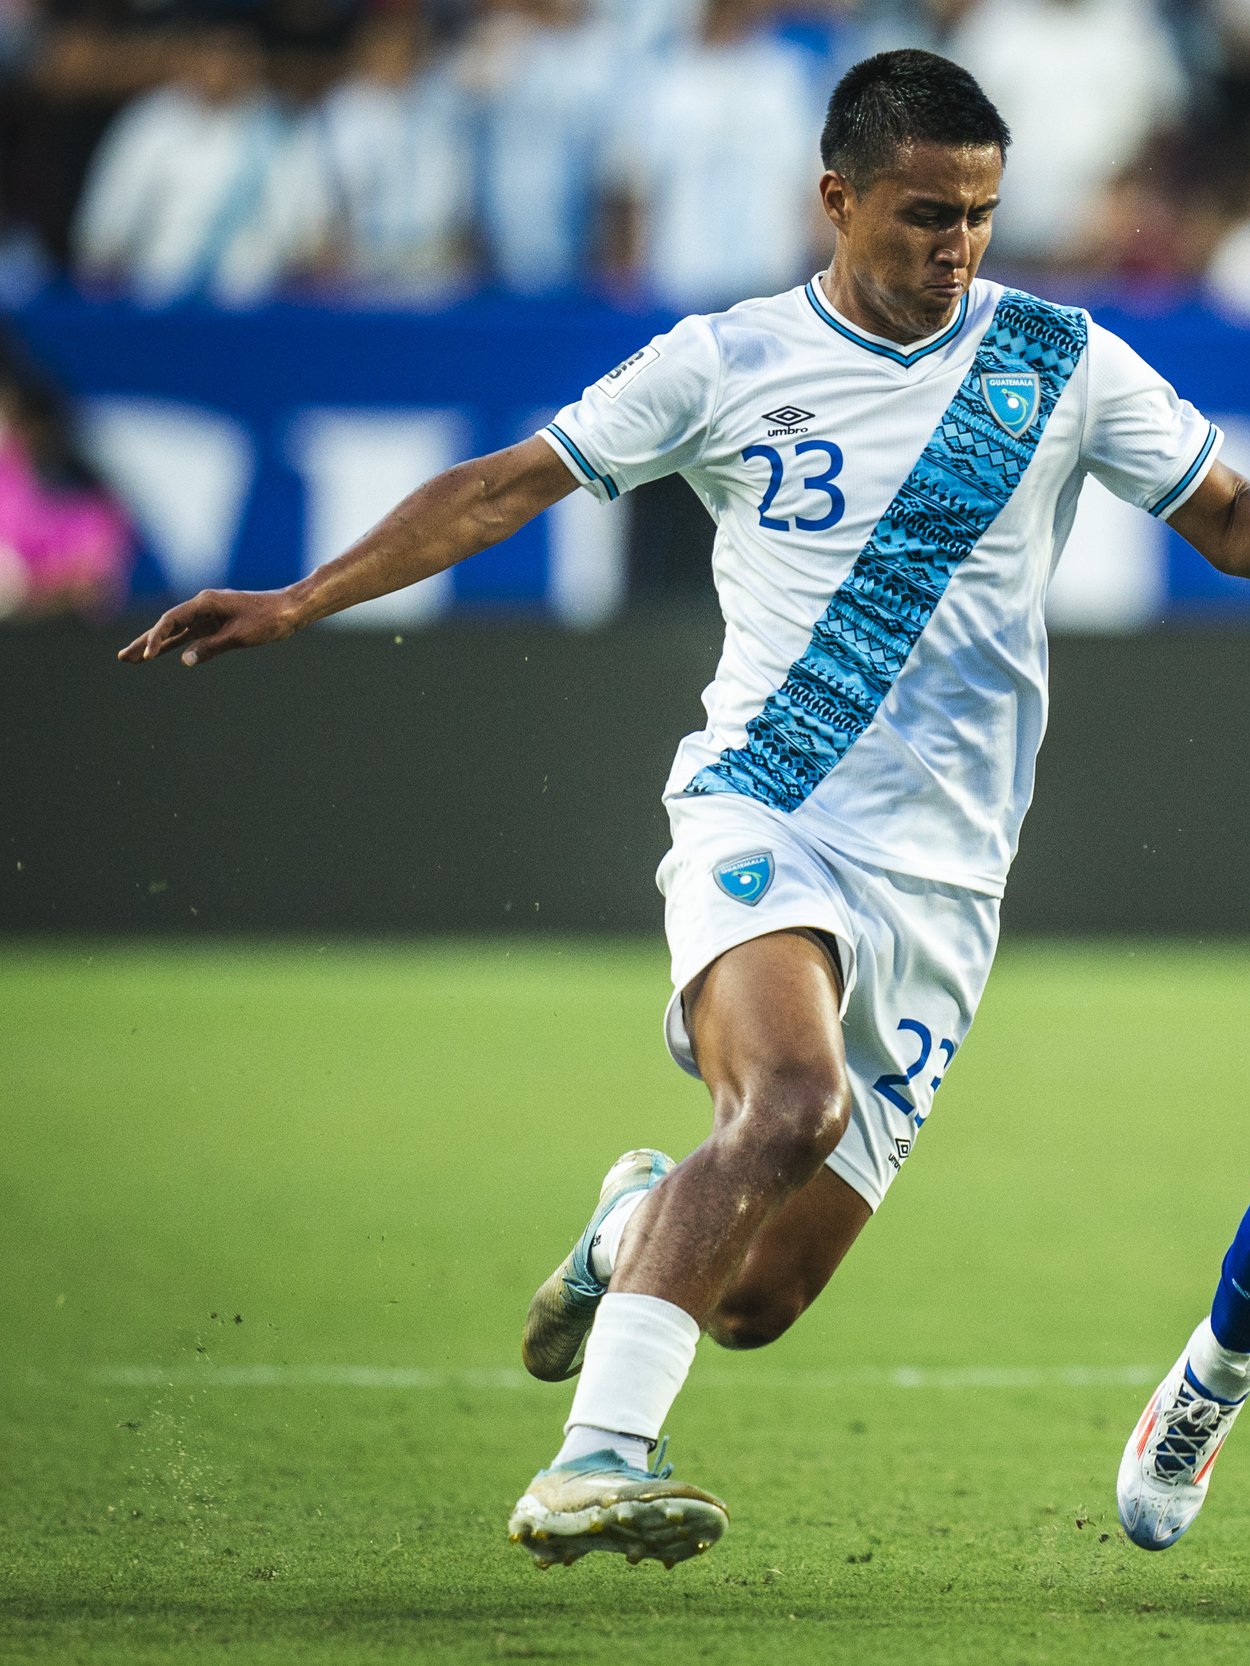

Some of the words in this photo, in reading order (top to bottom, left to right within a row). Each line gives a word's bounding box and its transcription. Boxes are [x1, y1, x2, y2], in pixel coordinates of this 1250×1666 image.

[989, 379, 1034, 387] GUATEMALA
[767, 426, 809, 437] umbro
[741, 440, 846, 532] 23
